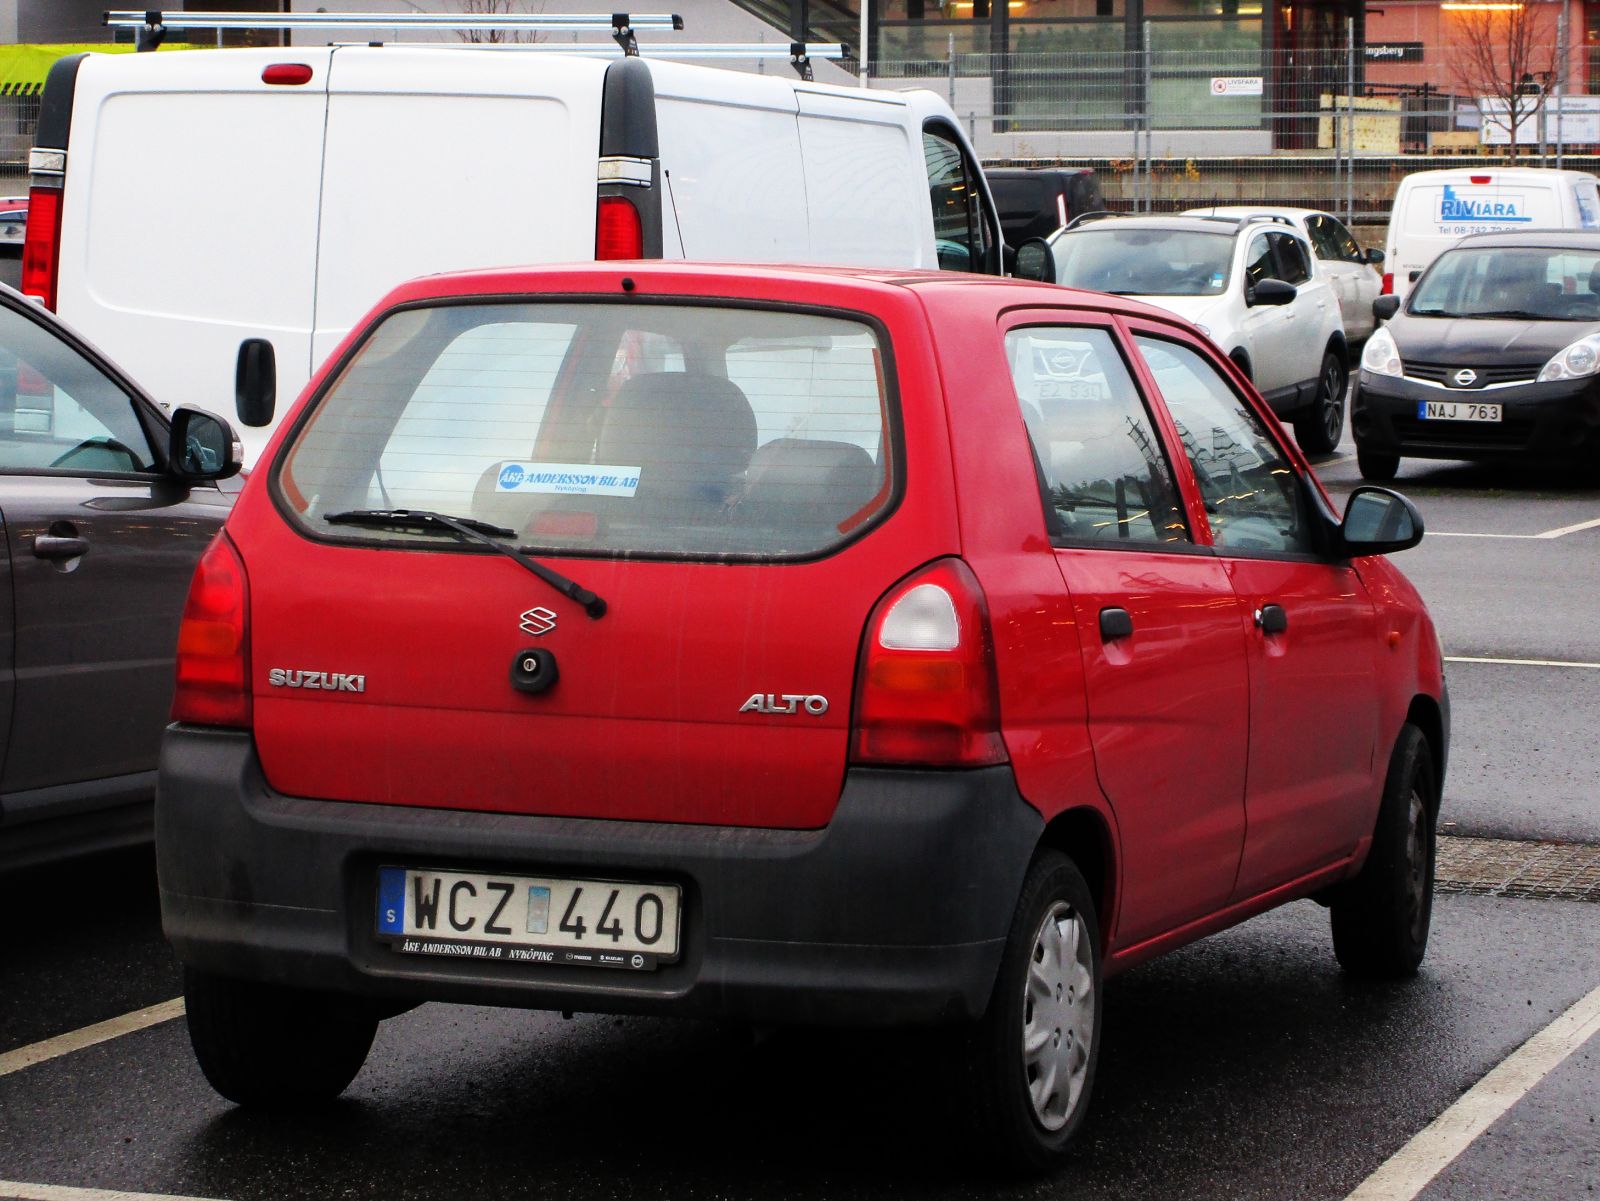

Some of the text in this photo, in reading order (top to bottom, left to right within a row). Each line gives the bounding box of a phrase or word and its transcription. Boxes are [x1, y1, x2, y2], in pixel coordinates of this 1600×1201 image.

[1364, 46, 1404, 57] ingsberg
[1439, 226, 1451, 234] Tel
[1427, 403, 1499, 420] NAJ 763
[526, 472, 597, 486] ANDERSSON
[599, 475, 617, 487] BIL
[620, 477, 638, 488] AB
[269, 668, 366, 693] SUZUKI
[738, 693, 829, 716] ALTO
[386, 909, 396, 923] S
[413, 875, 664, 946] WCZ 440
[402, 938, 554, 961] ÅKE ANDERSSON BIL AB NYKÖPING
